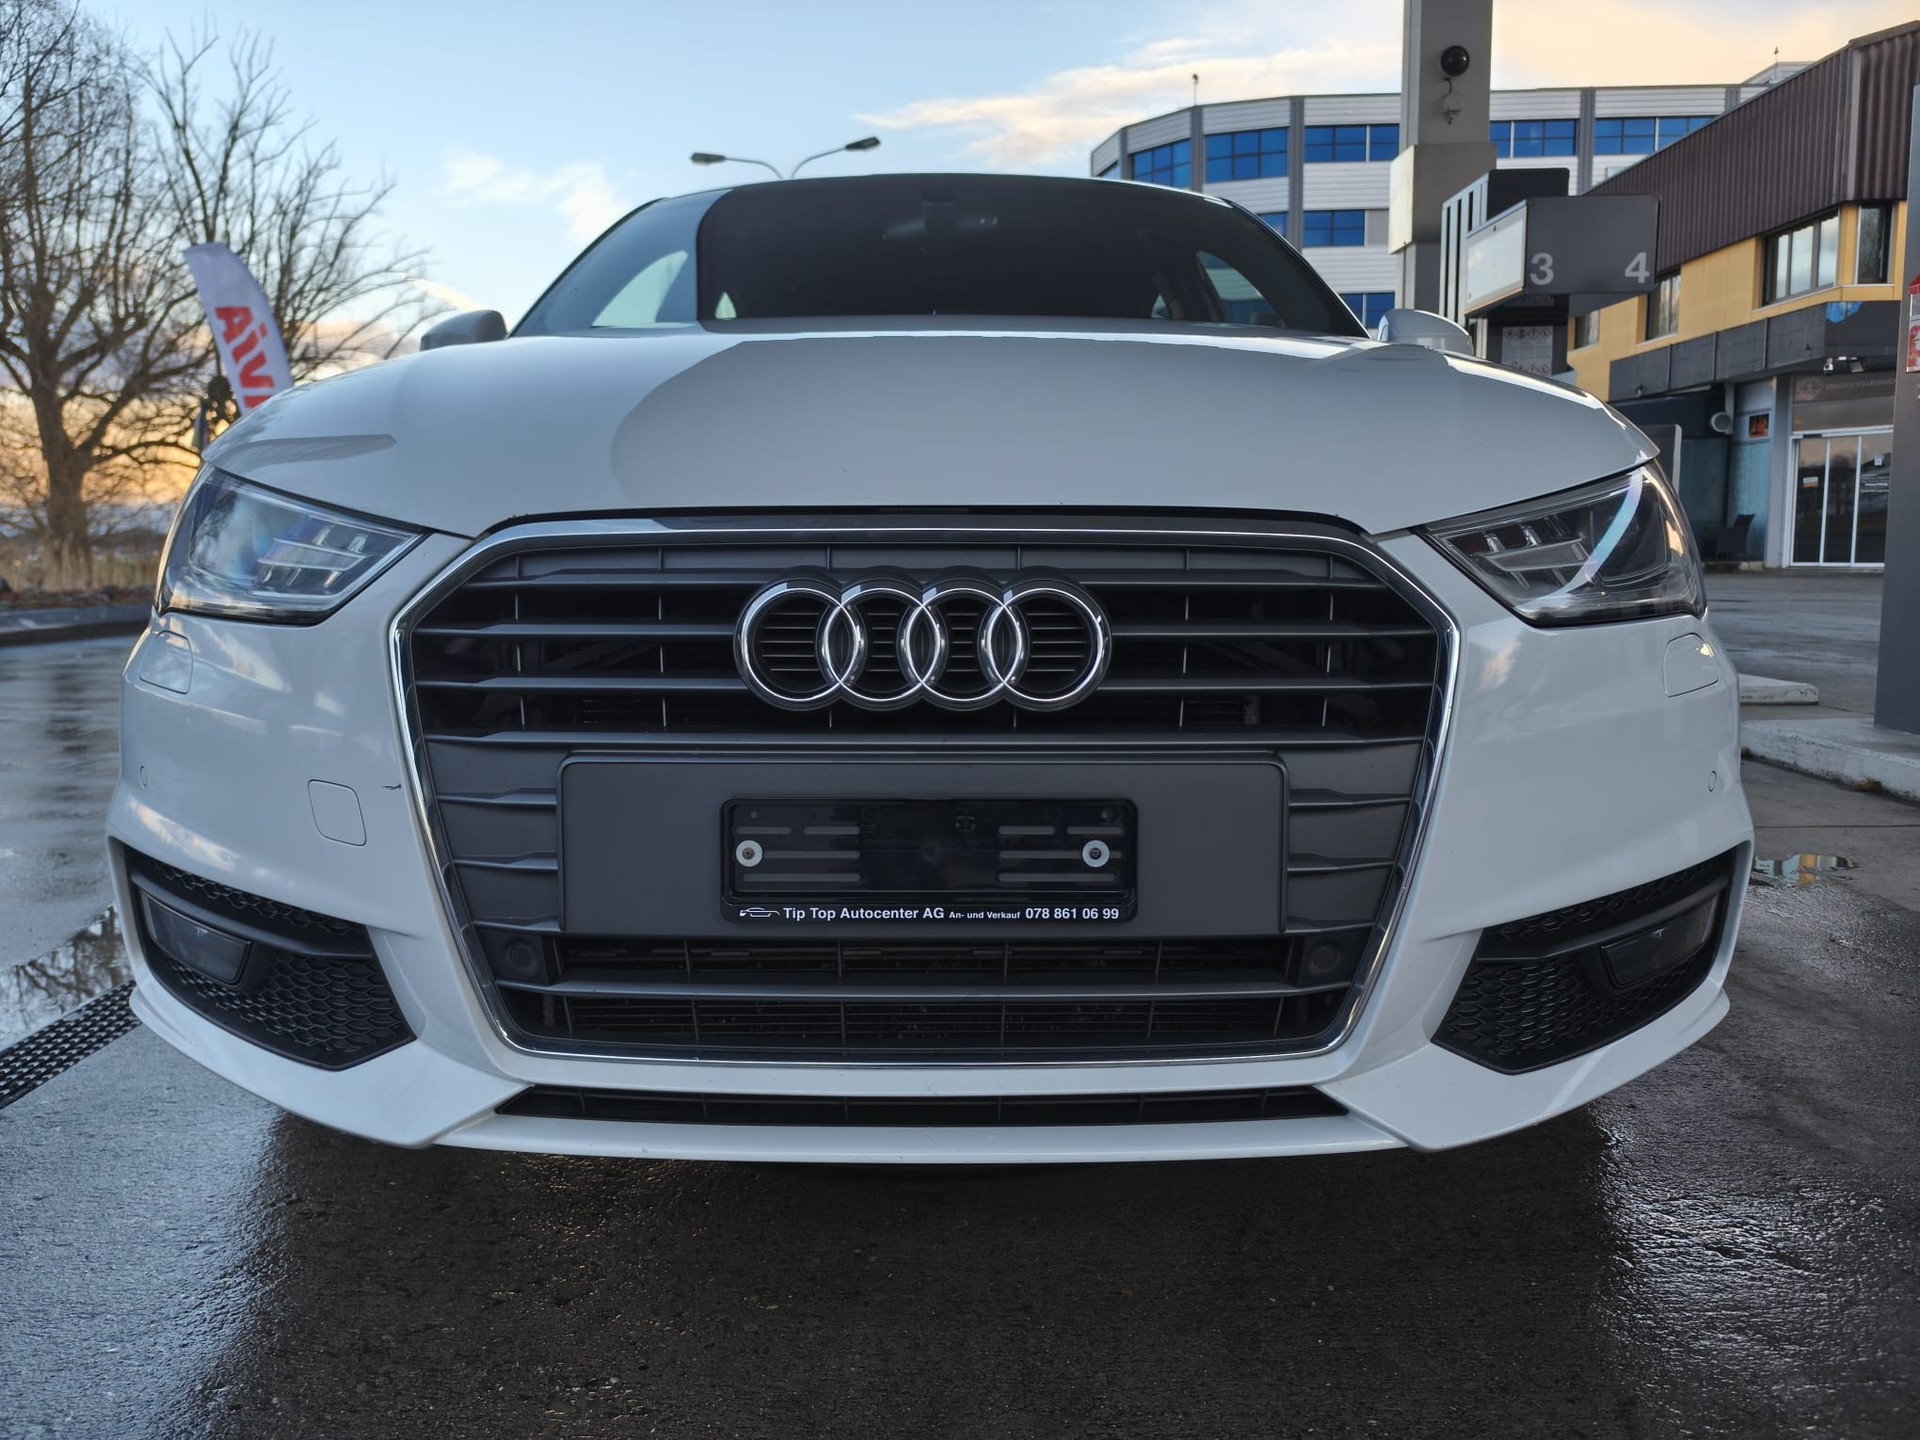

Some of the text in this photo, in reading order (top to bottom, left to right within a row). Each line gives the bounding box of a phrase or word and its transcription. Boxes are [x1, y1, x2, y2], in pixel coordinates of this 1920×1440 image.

[1530, 252, 1554, 285] 3
[1624, 252, 1650, 284] 4
[783, 907, 1119, 921] Tip Top Autocenter AG An- und Verkauf 078 861 06 99
